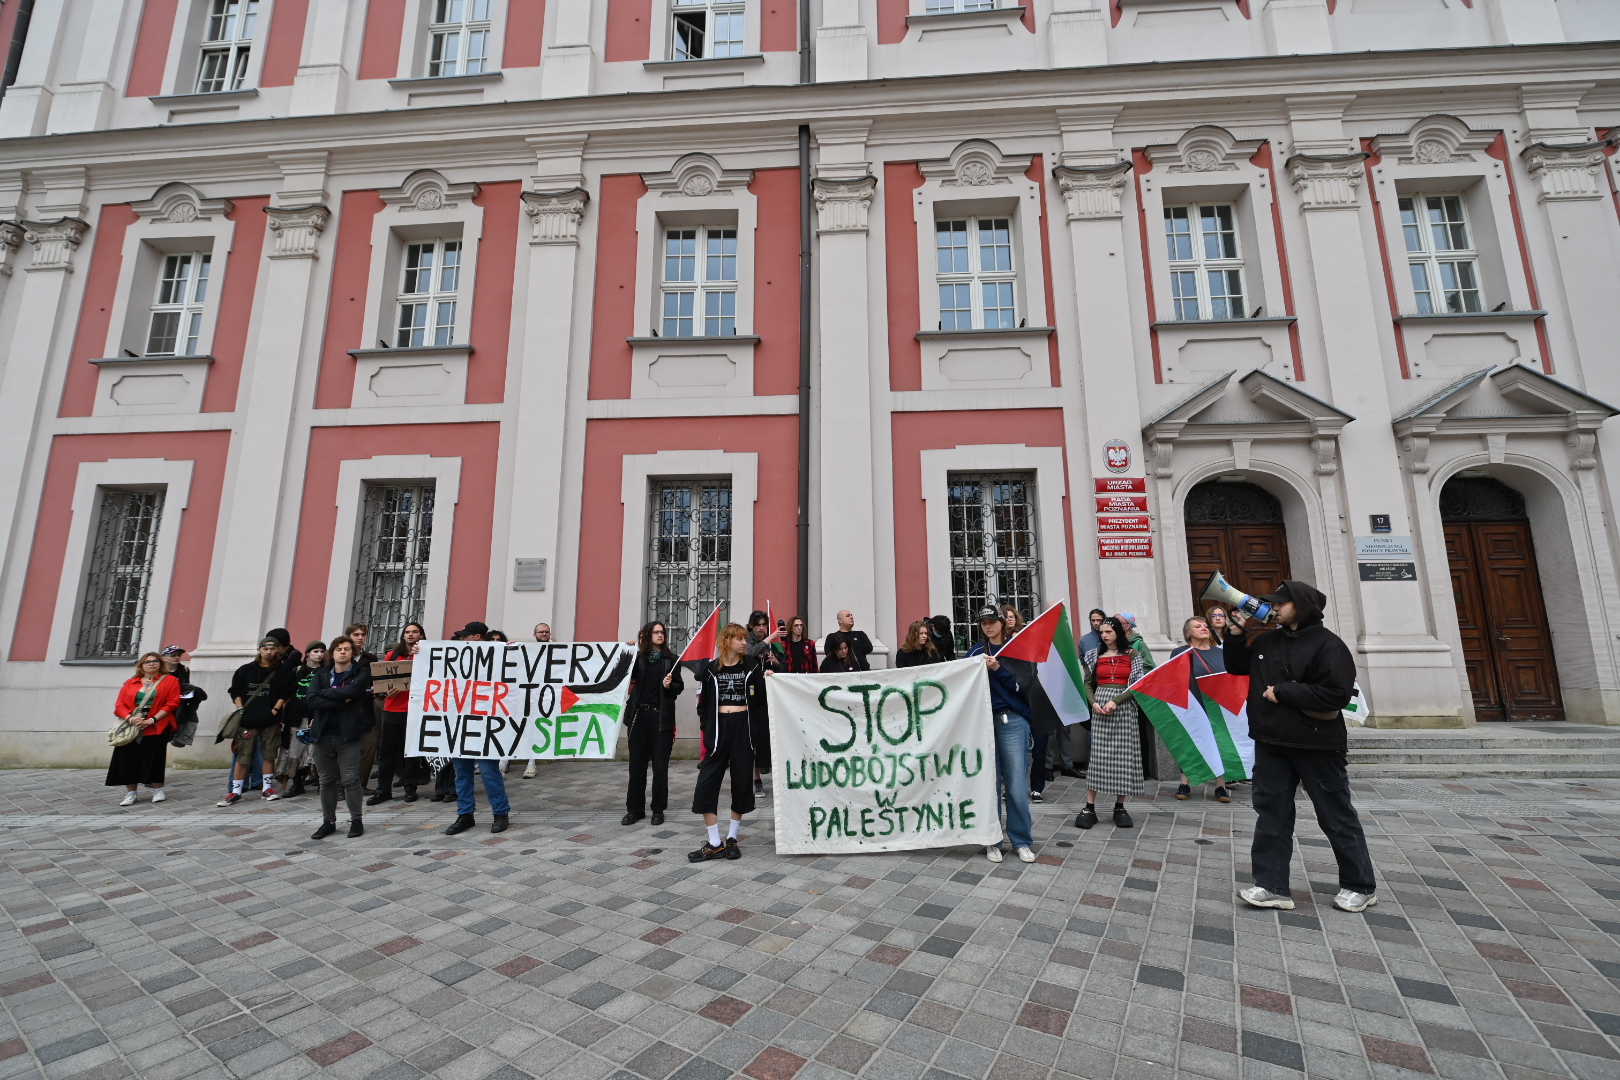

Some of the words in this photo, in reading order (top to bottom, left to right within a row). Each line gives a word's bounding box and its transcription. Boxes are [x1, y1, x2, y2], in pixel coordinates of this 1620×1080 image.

[386, 666, 399, 675] WY
[428, 646, 494, 681] FROM
[501, 643, 619, 684] EVERY
[423, 679, 509, 716] RIVER
[518, 683, 556, 718] TO
[818, 678, 948, 754] STOP
[419, 715, 527, 757] EVERY
[532, 714, 606, 756] SEA
[786, 743, 983, 790] LUDOBÓJSTWU
[874, 790, 898, 808] W
